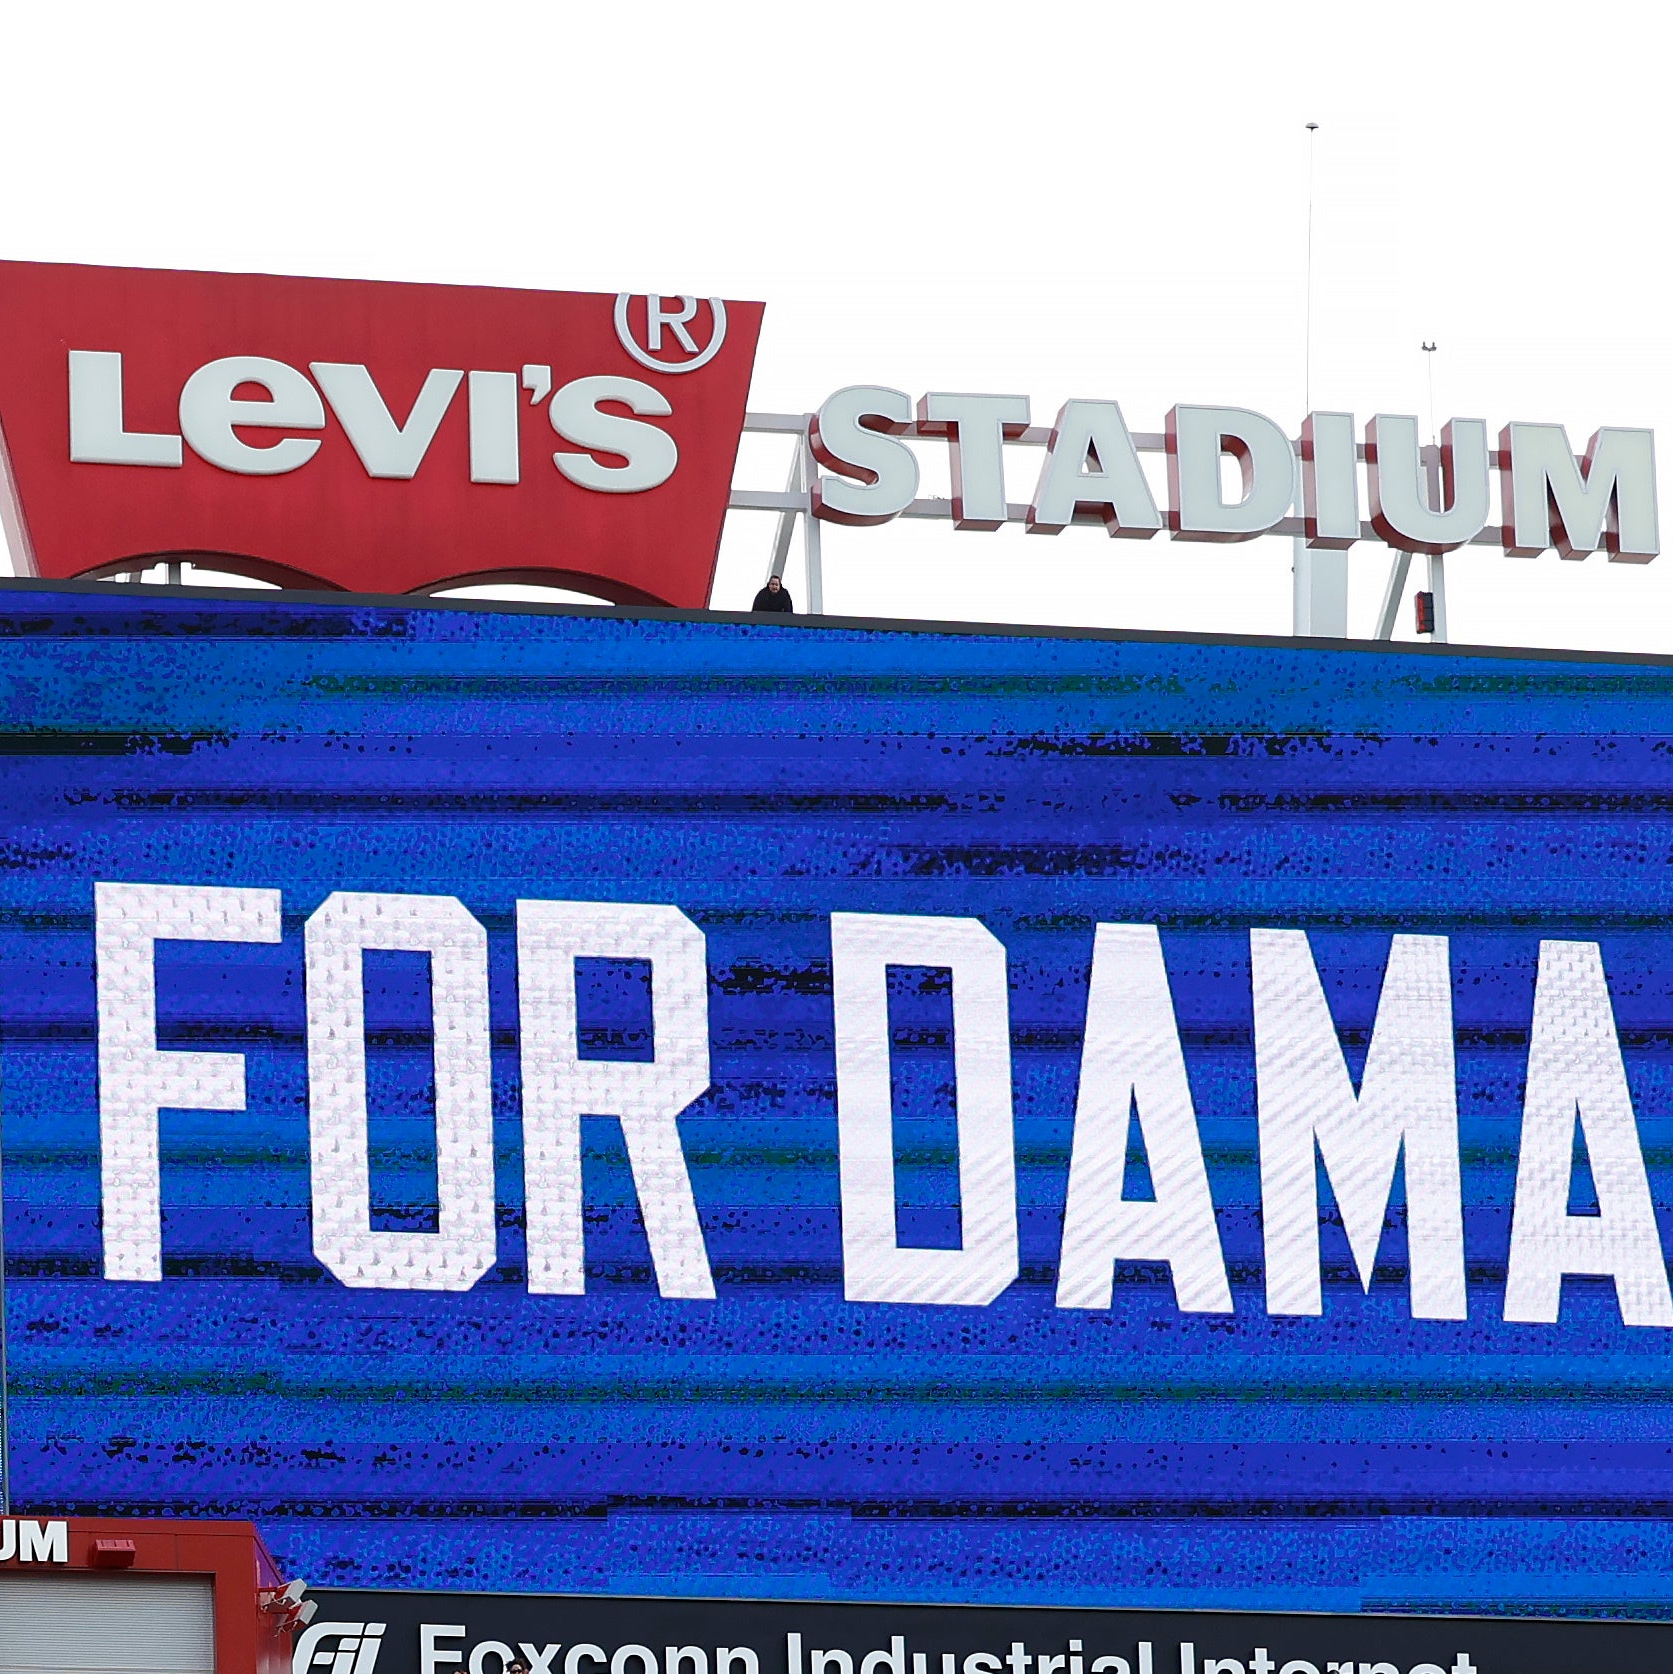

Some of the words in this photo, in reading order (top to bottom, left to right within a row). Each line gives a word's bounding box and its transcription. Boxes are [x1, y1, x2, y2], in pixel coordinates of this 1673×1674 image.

[68, 350, 679, 493] LeVI'S
[809, 385, 1661, 565] STADIUM
[95, 882, 717, 1299] FOR
